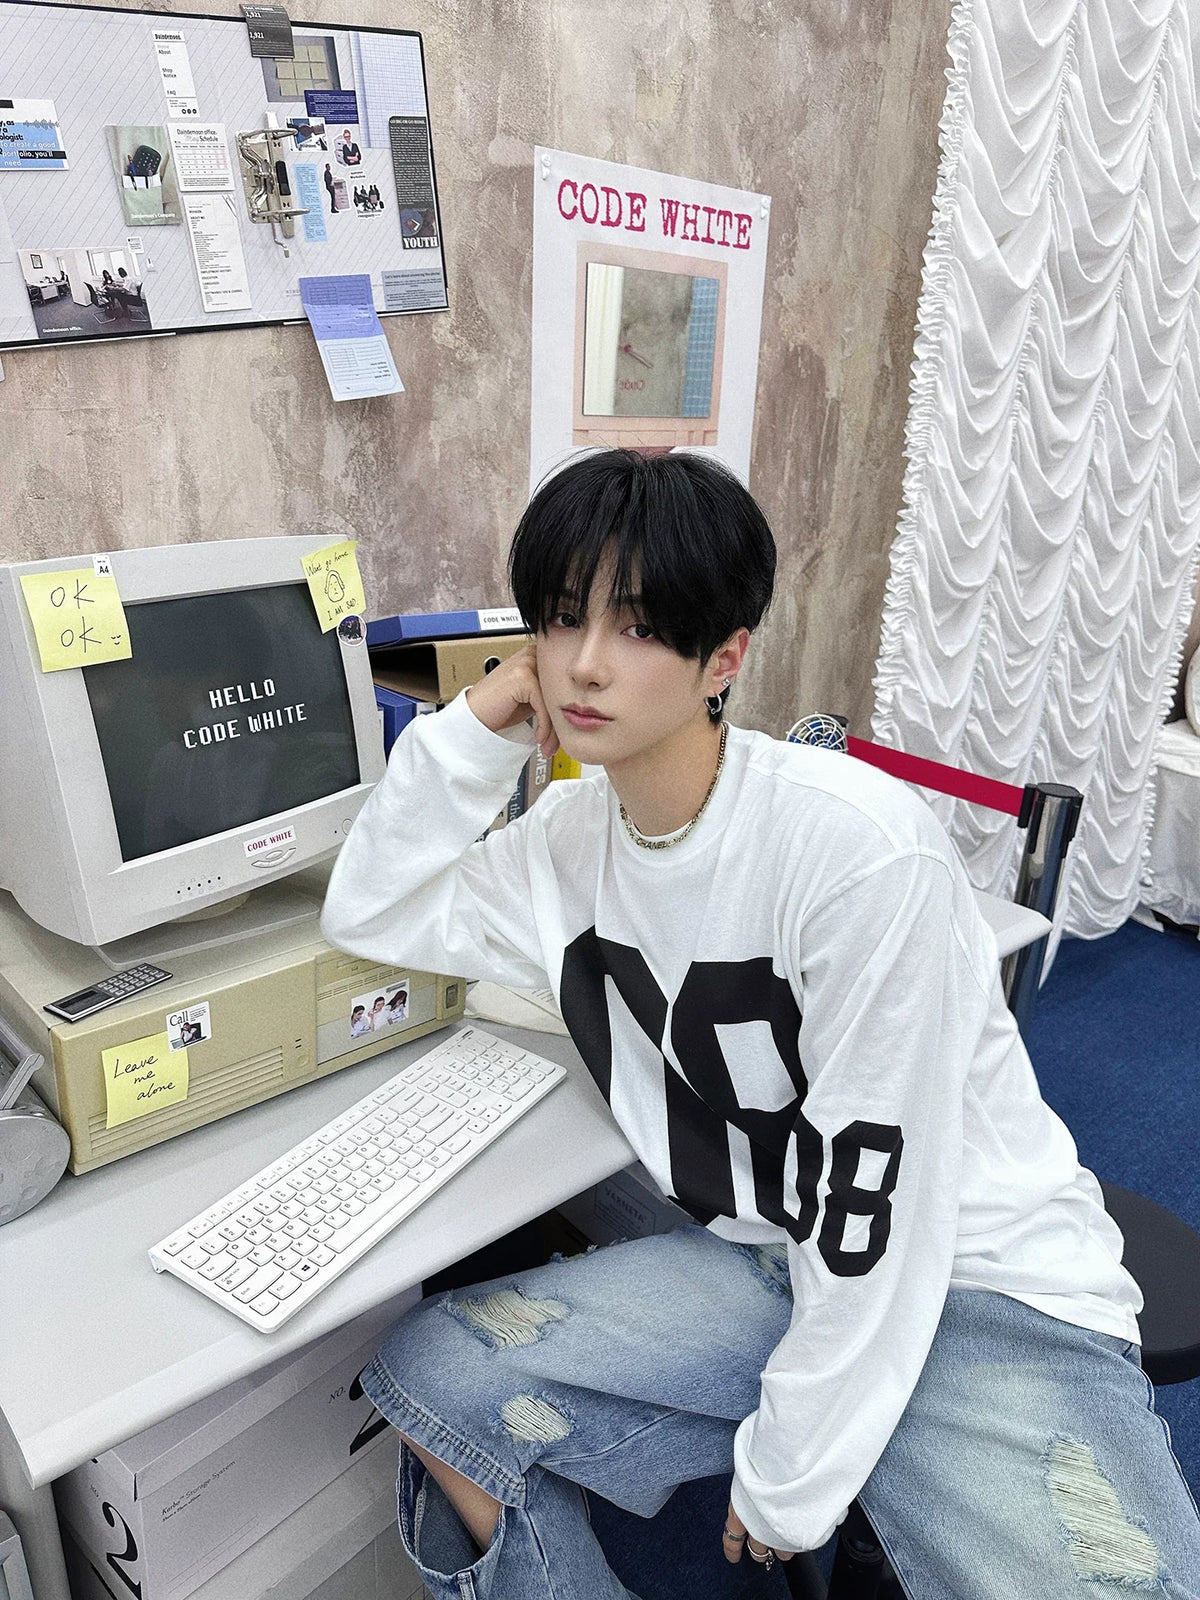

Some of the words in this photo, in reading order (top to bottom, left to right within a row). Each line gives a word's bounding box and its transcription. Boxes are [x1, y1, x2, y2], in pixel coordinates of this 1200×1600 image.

[558, 179, 647, 232] CODE
[660, 198, 752, 250] WHITE
[403, 236, 438, 249] YOUTH
[99, 566, 109, 574] A4
[306, 562, 322, 577] Want
[325, 560, 332, 571] go
[50, 578, 95, 610] OK
[328, 610, 332, 621] I
[335, 605, 343, 615] AM
[61, 616, 102, 653] OK
[209, 678, 276, 709] HELLO
[183, 720, 241, 749] CODE
[248, 703, 307, 733] WHITE
[247, 838, 267, 852] CODE
[270, 830, 292, 844] WHITE
[170, 1010, 189, 1026] Call
[114, 1056, 158, 1078] Leave
[134, 1070, 156, 1084] me
[137, 1082, 175, 1100] alone
[328, 1387, 346, 1404] NO.
[212, 1461, 236, 1480] System
[102, 1501, 142, 1600] 2
